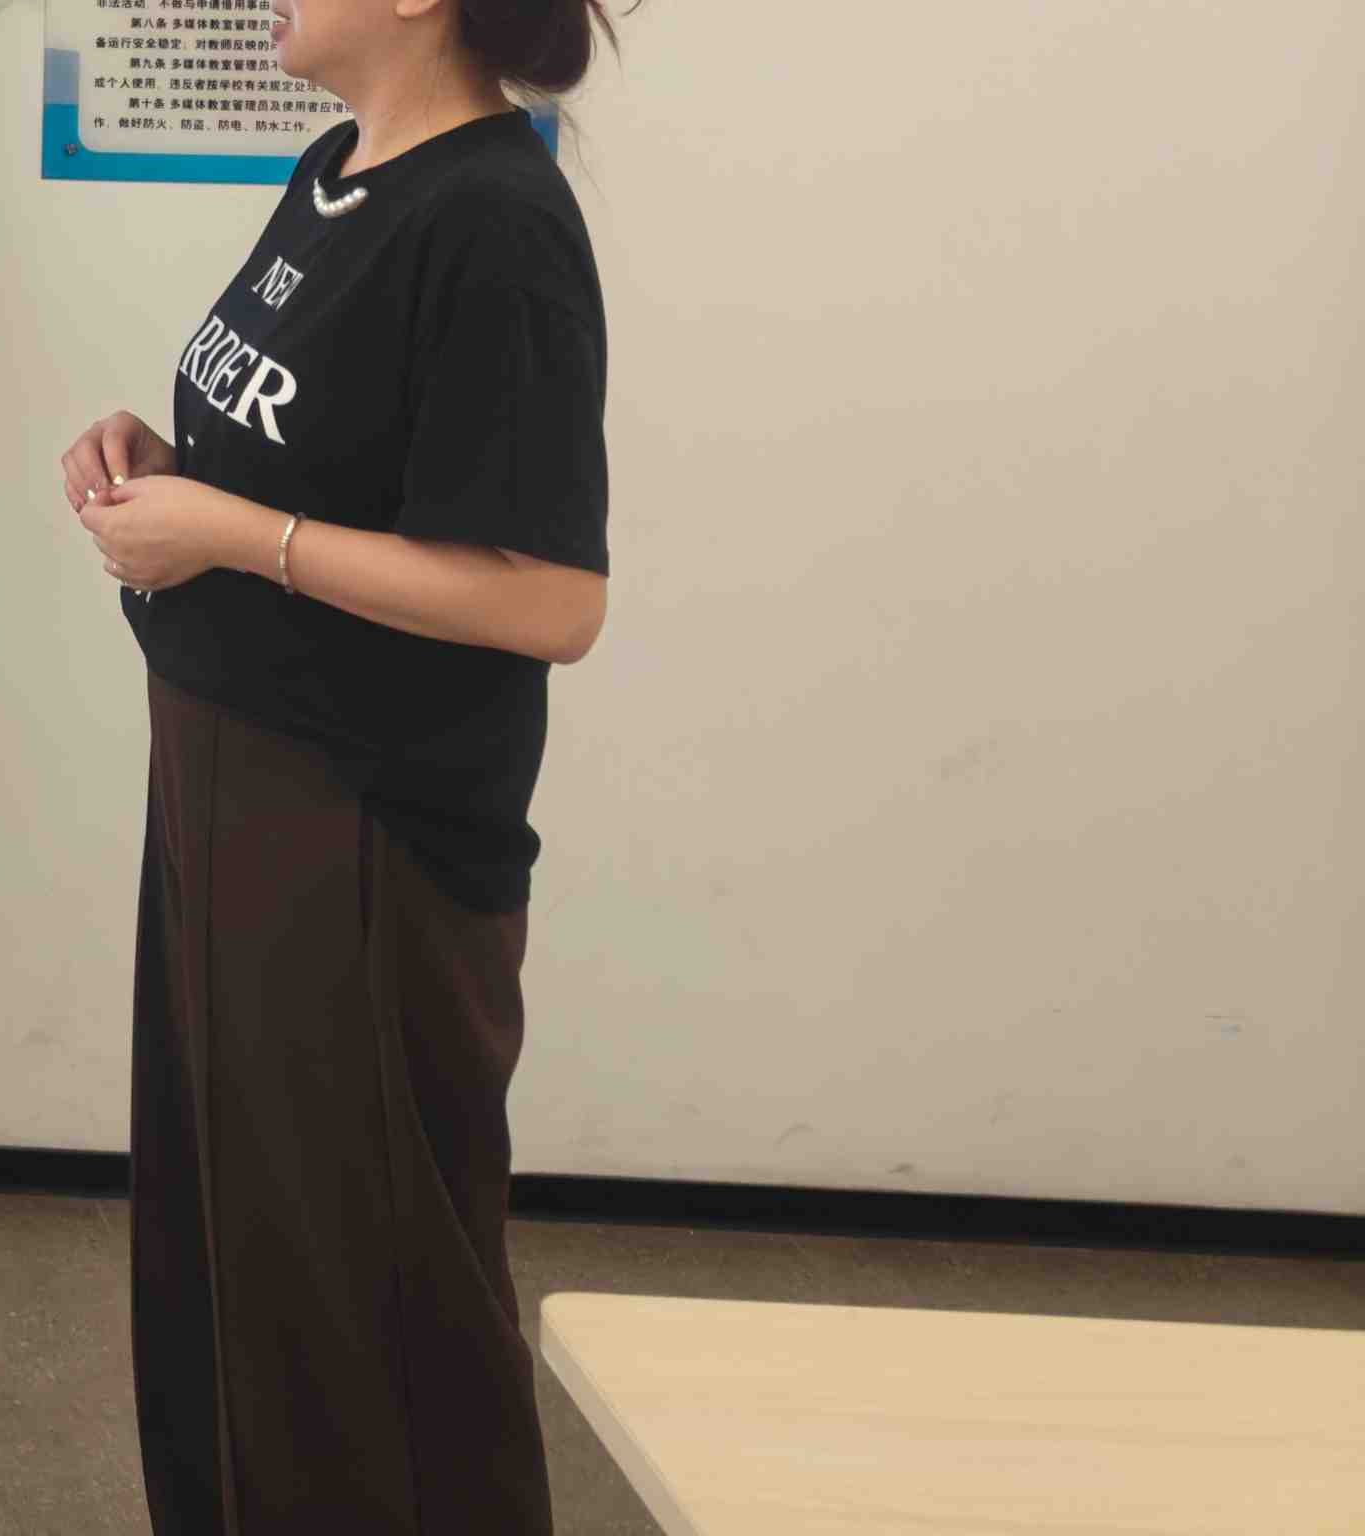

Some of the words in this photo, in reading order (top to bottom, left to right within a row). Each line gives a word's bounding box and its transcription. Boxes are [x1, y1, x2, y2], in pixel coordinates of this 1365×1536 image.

[129, 17, 168, 32] 第八条
[128, 57, 166, 72] 第九条
[127, 97, 165, 111] 第十条
